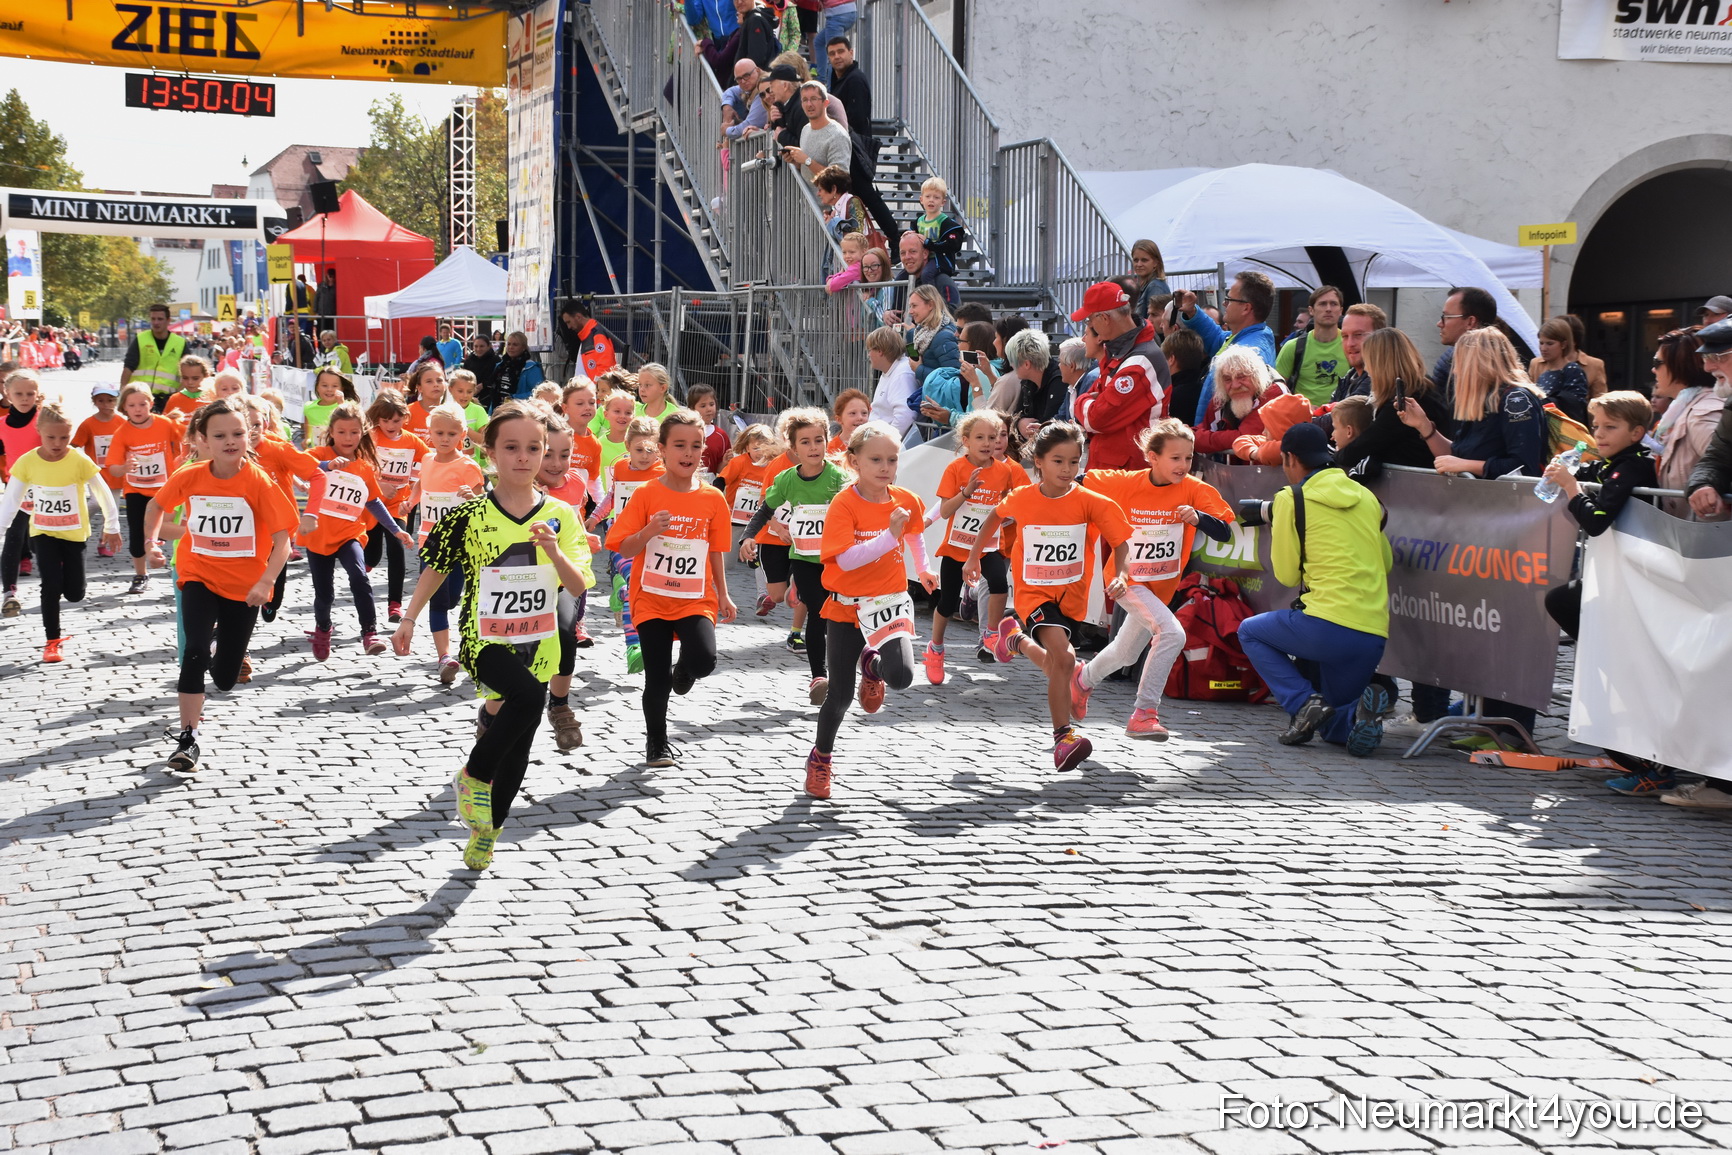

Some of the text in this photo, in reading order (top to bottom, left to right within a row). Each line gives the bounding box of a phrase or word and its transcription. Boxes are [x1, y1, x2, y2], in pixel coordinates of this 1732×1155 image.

[1615, 0, 1720, 25] swn
[0, 20, 24, 32] auf
[112, 4, 261, 60] ZIEL
[1613, 27, 1682, 40] stadtwerke
[341, 45, 475, 60] Neumarkter Stadtlauf
[1640, 44, 1657, 54] wir
[1658, 44, 1691, 55] bieten
[31, 198, 236, 226] MINI NEUMARKT.
[1528, 229, 1567, 242] Infopoint
[222, 303, 232, 316] A
[381, 459, 408, 474] 7176
[328, 484, 362, 504] 7178
[39, 499, 72, 513] 7245
[425, 505, 457, 520] 710
[1130, 508, 1172, 517] Neumarkter
[198, 515, 244, 534] 7107
[962, 515, 985, 533] 72
[1130, 515, 1164, 525] Stadtlauf
[210, 540, 230, 548] Tessa
[1134, 541, 1176, 560] 7253
[1033, 543, 1077, 562] 7262
[1389, 535, 1449, 572] STRY
[654, 552, 697, 575] 7192
[1447, 544, 1549, 586] LOUNGE
[1035, 567, 1073, 578] Fiona
[664, 579, 681, 588] Julia
[490, 588, 547, 615] 7259
[1387, 585, 1502, 633] ckonline.de
[489, 620, 540, 633] EMMA
